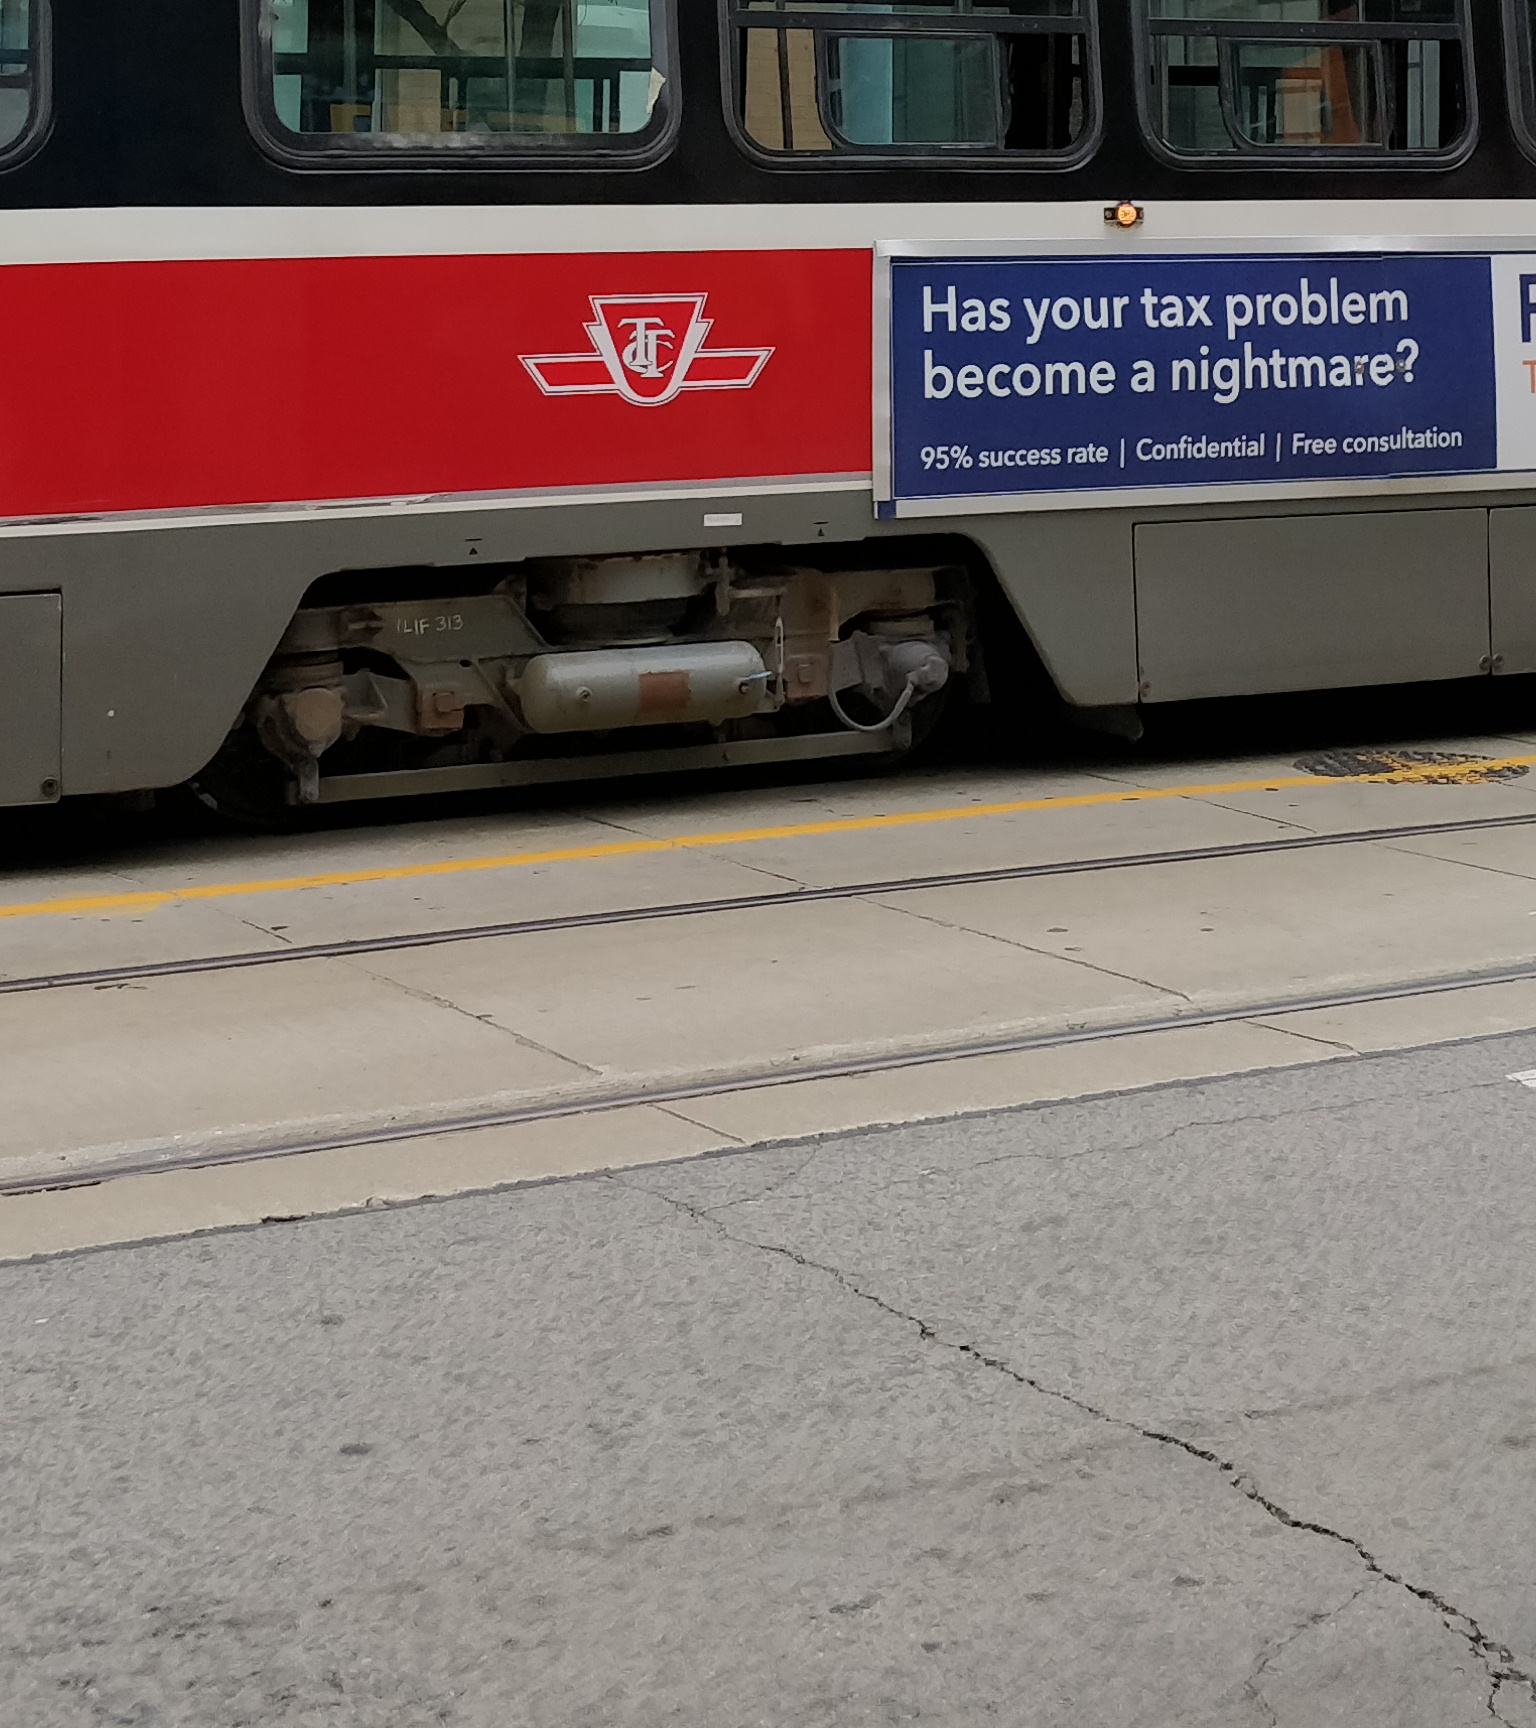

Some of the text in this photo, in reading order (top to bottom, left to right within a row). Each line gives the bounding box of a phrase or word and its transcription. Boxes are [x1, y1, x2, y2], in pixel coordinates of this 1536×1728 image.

[923, 277, 1409, 344] Has your tax problem
[923, 338, 1420, 404] become a nightmare?
[920, 444, 973, 470] 95%
[978, 444, 1062, 469] success
[1067, 443, 1109, 465] rate
[1135, 434, 1266, 463] Confidential
[1292, 432, 1337, 456] Free
[1341, 426, 1463, 455] consultation
